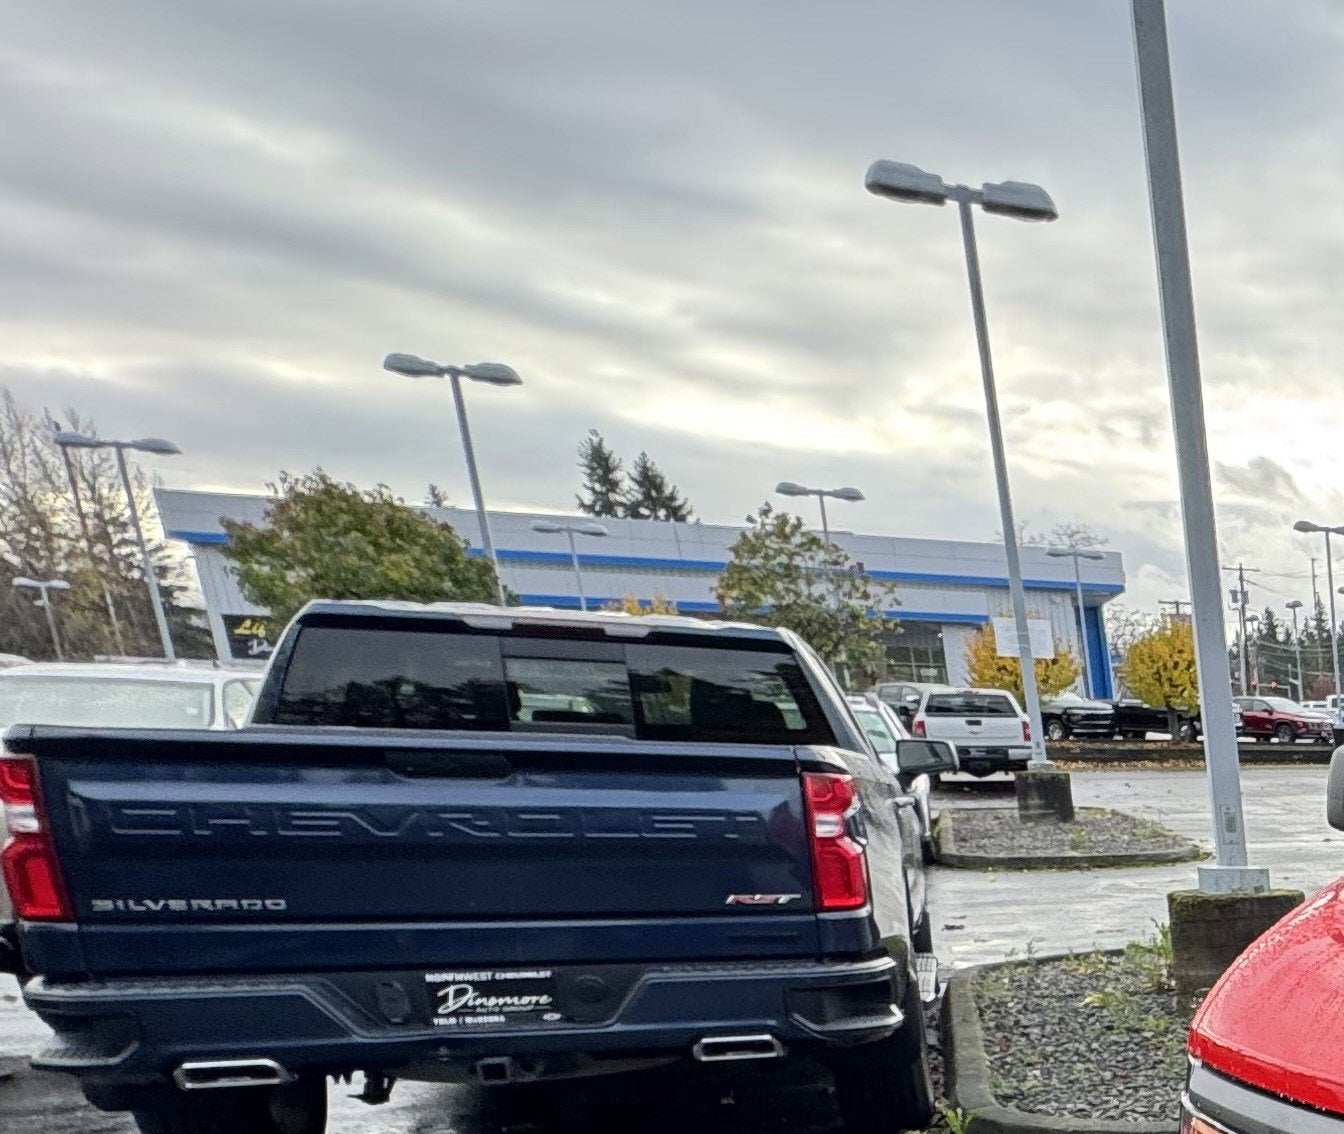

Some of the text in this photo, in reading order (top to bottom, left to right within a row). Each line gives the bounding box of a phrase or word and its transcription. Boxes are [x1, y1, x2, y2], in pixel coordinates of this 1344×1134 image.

[110, 807, 758, 838] CHEVROLET
[92, 899, 287, 912] SILVERADO
[725, 894, 801, 905] RST
[436, 983, 553, 1015] Dinsmore
